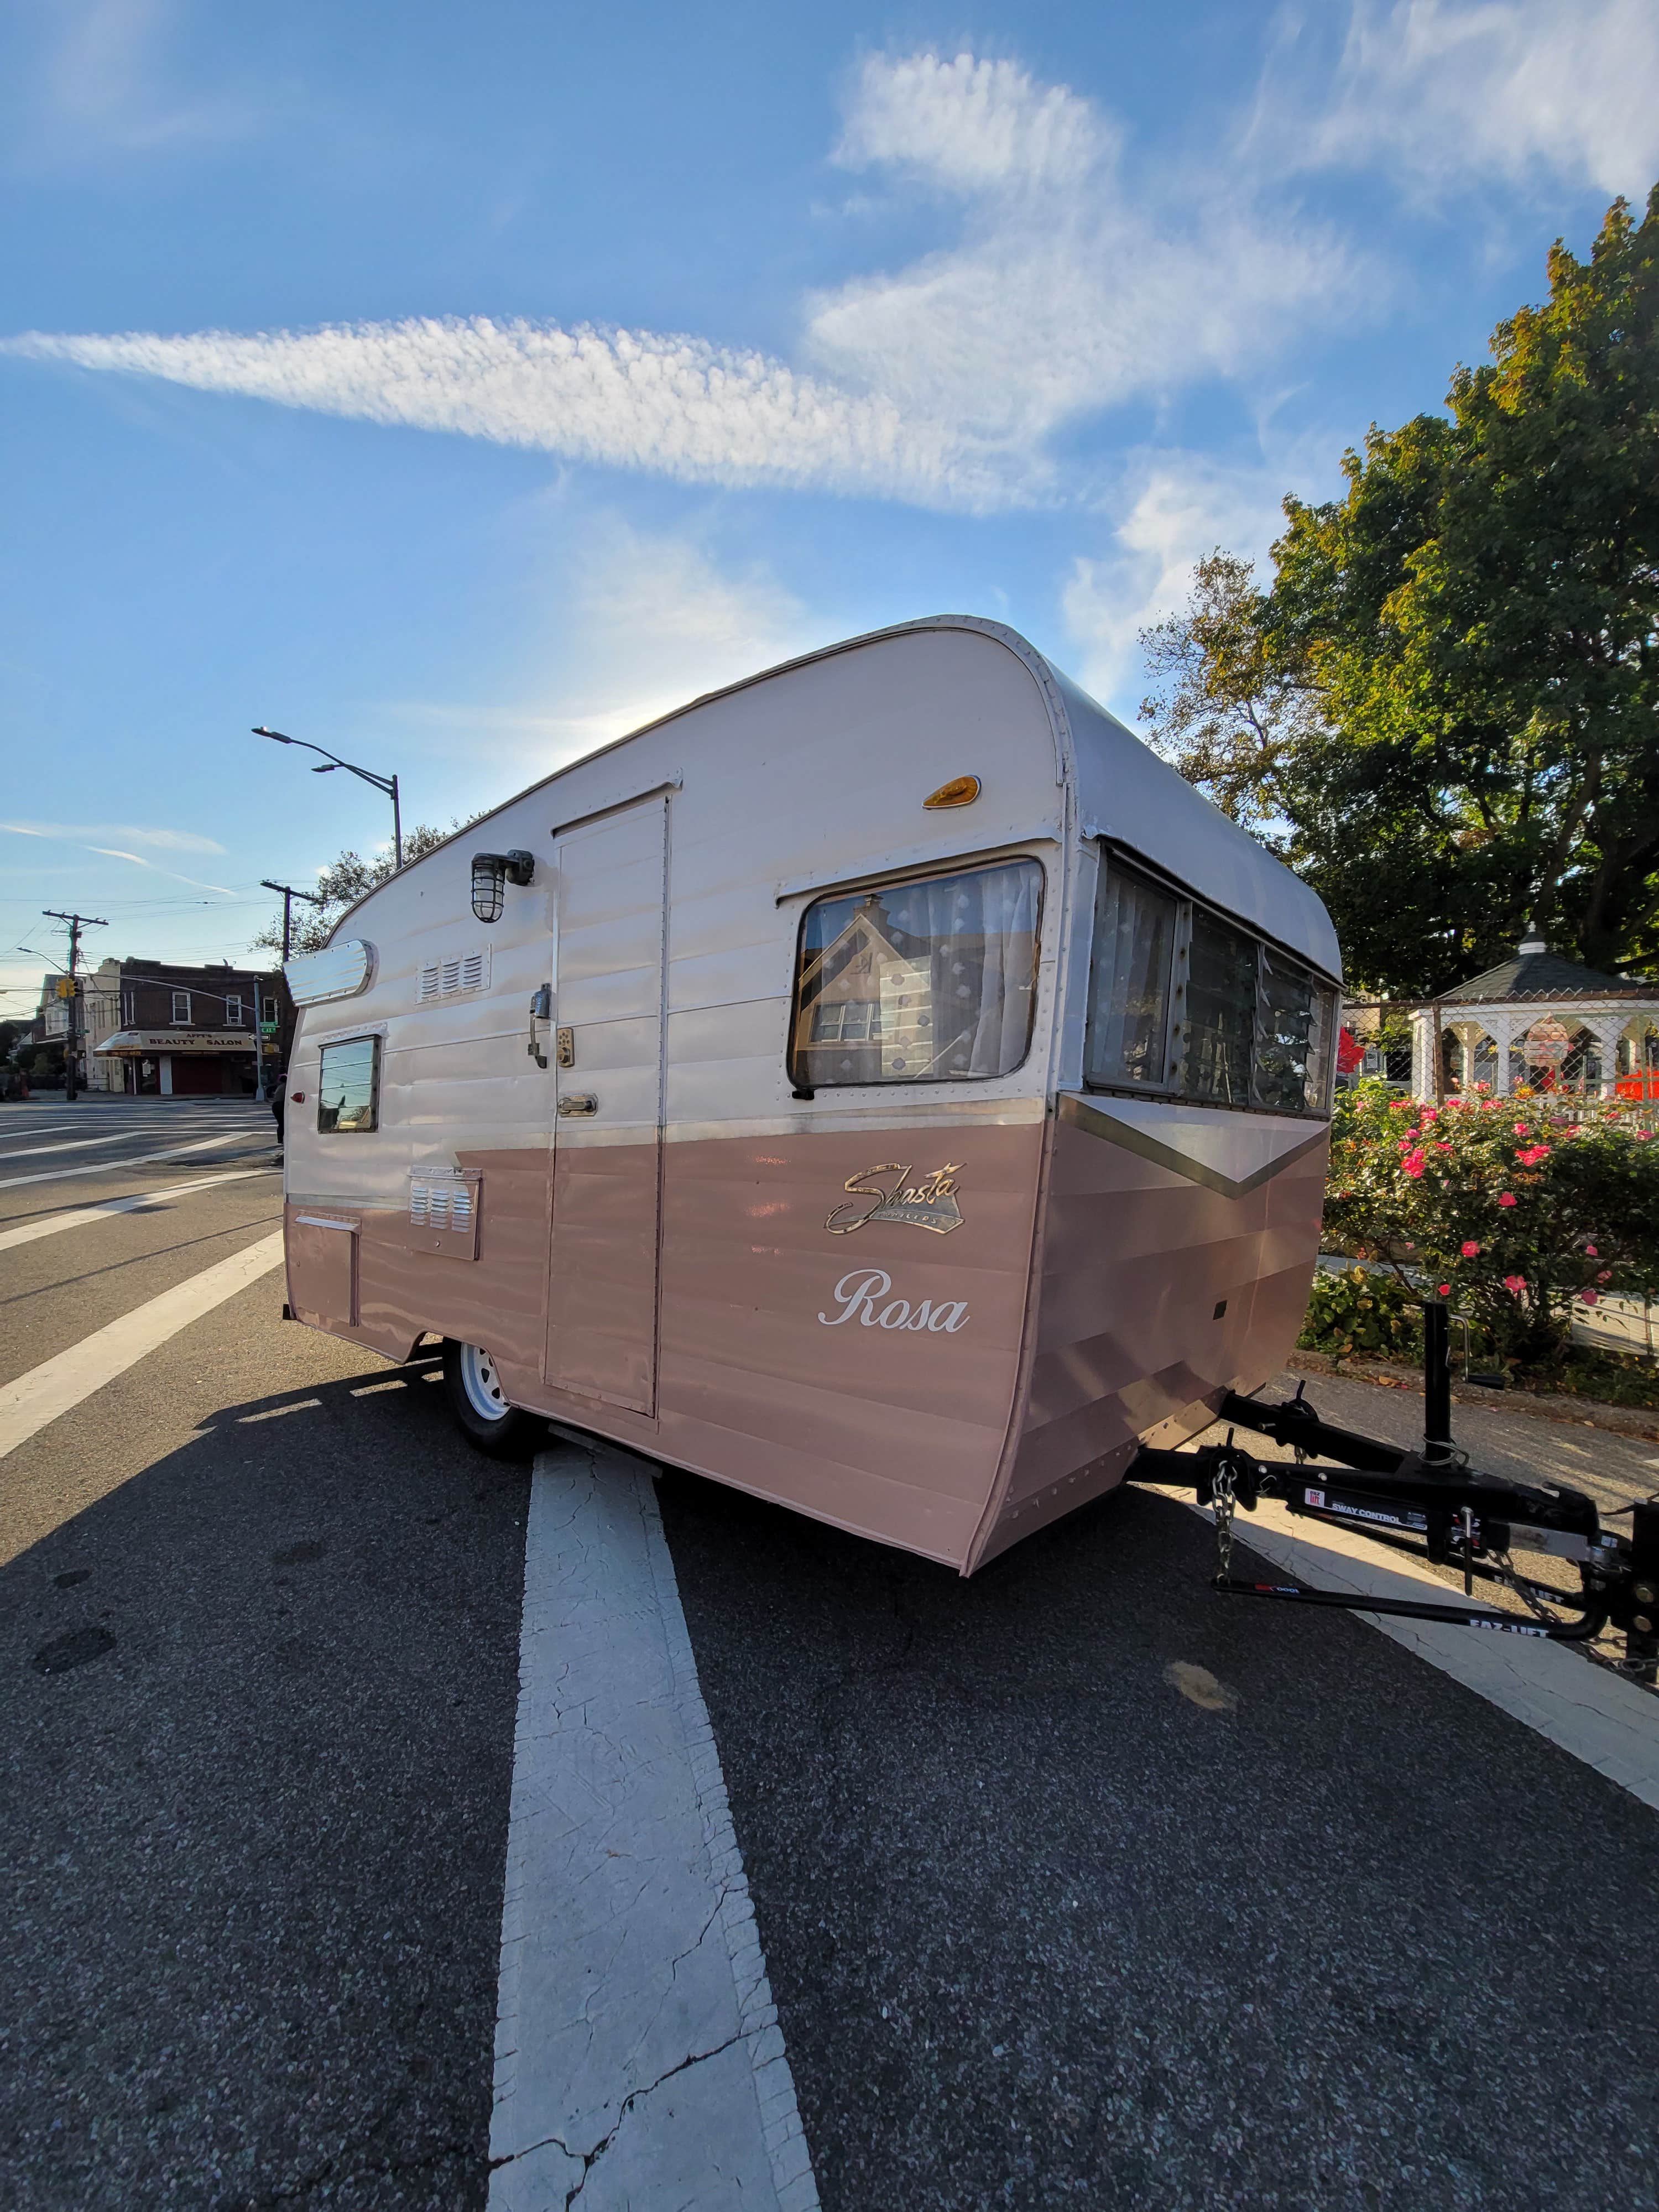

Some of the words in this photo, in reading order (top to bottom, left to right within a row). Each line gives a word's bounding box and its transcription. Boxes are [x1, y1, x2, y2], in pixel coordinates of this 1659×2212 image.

[826, 1162, 967, 1234] Shasta
[879, 1212, 938, 1224] AILERS
[818, 1269, 971, 1333] Rosa
[1332, 1503, 1360, 1515] SWAY
[1358, 1509, 1400, 1523] CONTROL
[1470, 1619, 1549, 1638] EAZ-LIFT
